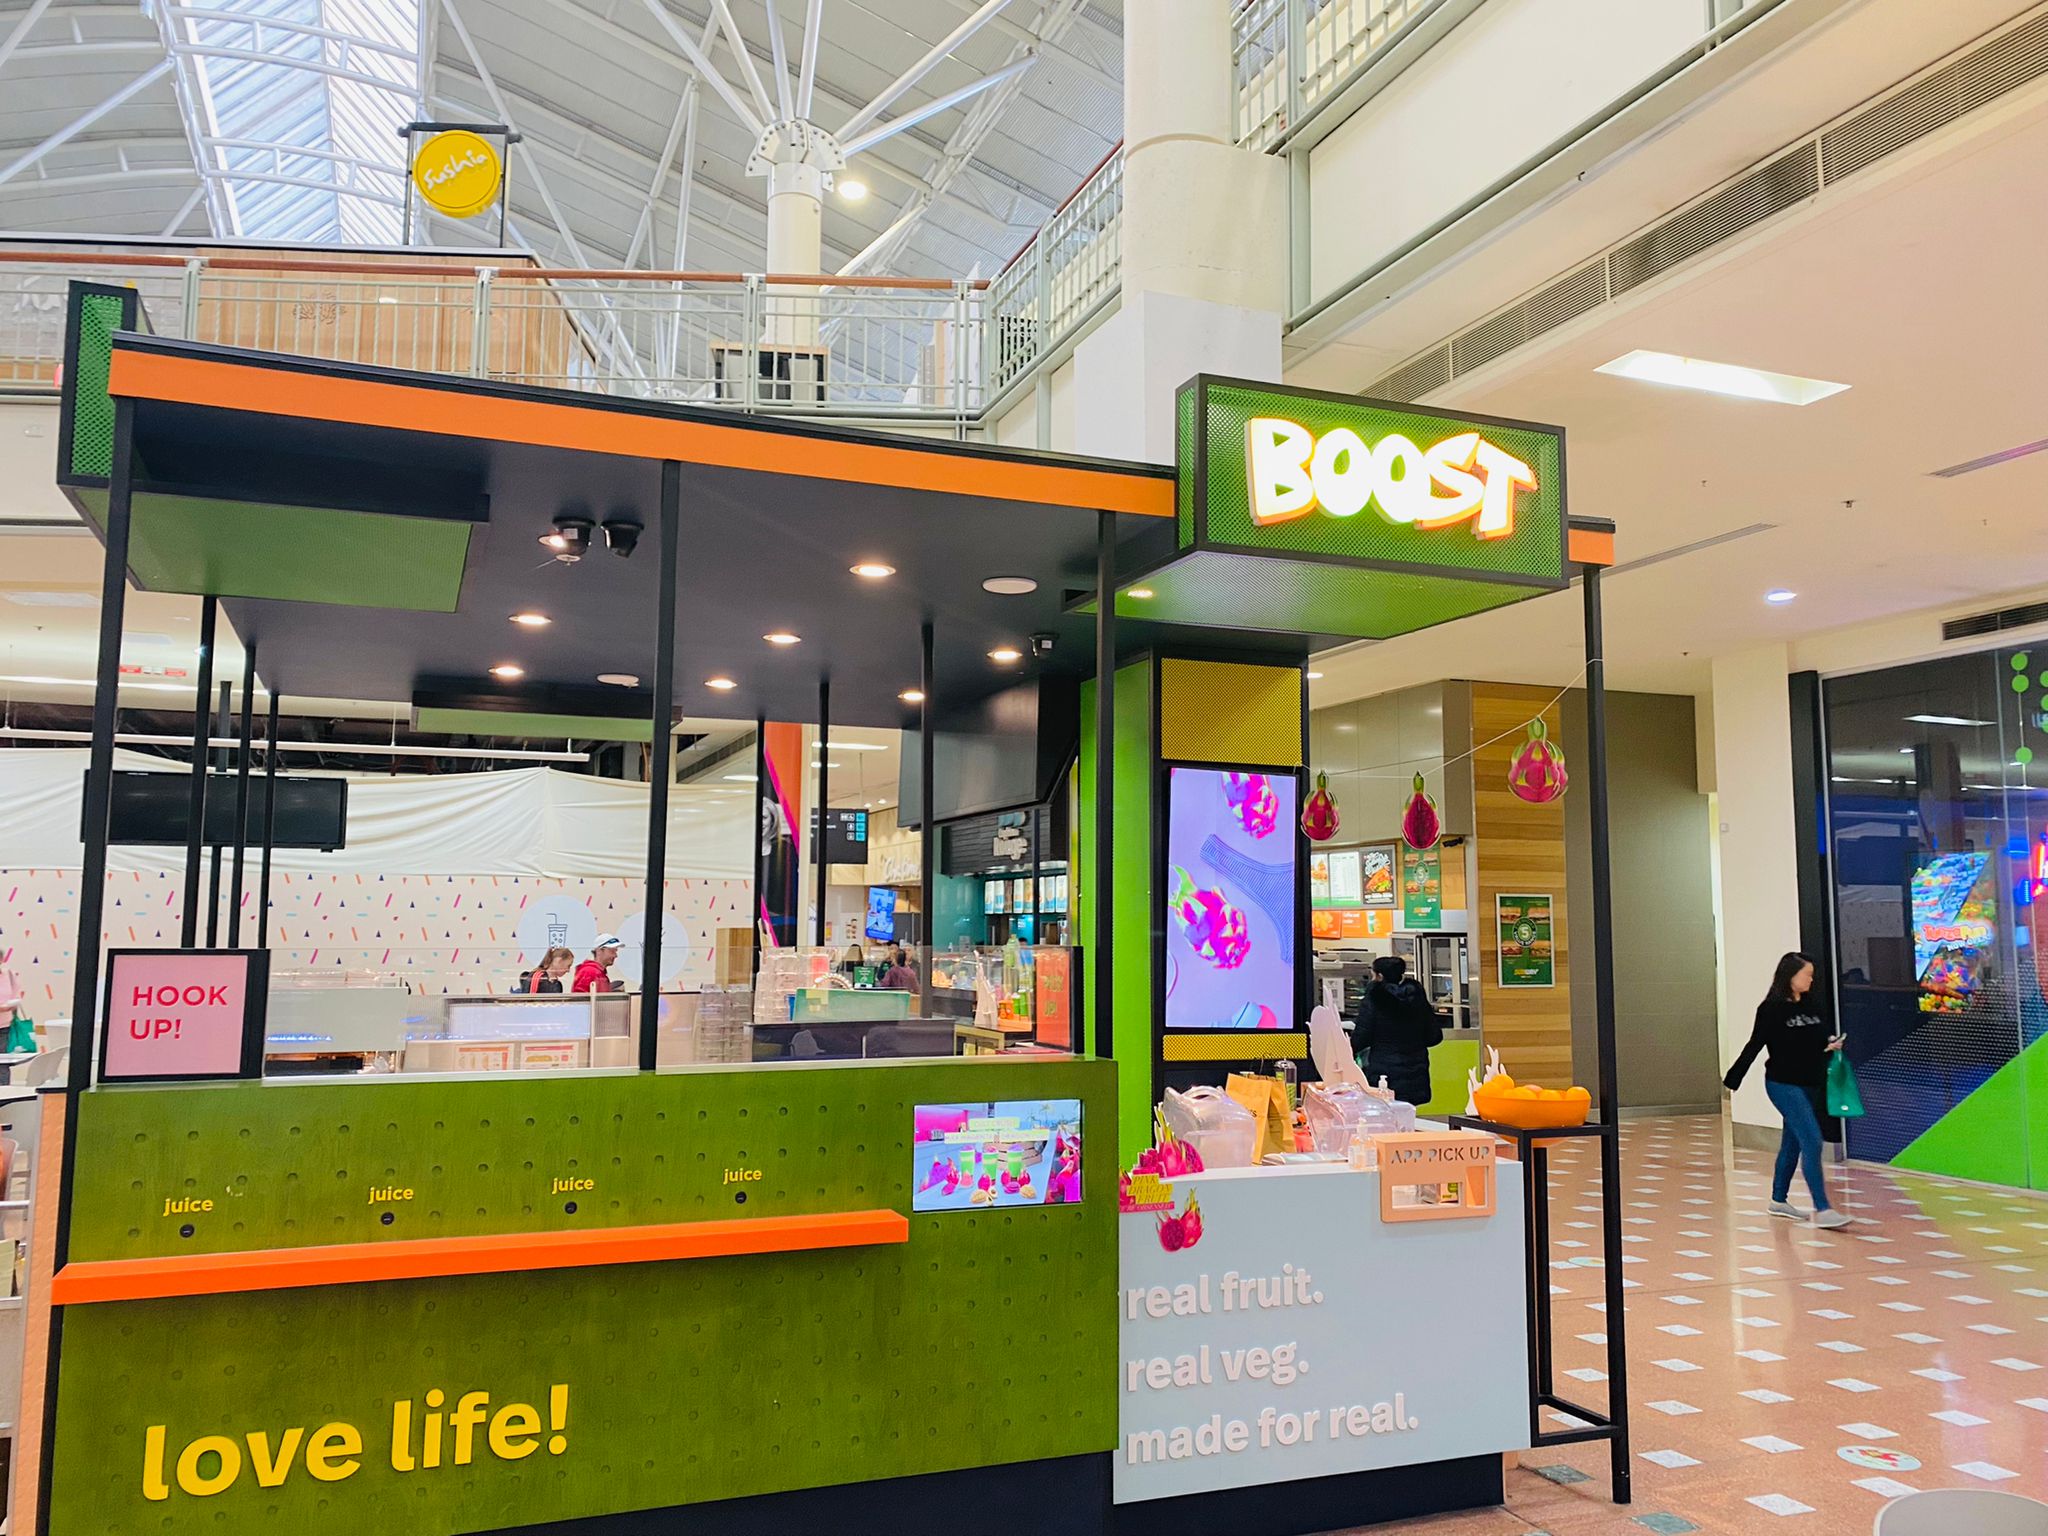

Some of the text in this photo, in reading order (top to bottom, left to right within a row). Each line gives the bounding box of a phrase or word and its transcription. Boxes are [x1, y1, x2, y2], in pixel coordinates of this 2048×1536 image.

[1246, 416, 1538, 540] BOOST
[132, 985, 228, 1007] HOOK
[130, 1018, 182, 1040] UP!
[1391, 1146, 1490, 1164] APP PICK UP
[552, 1176, 595, 1194] juice
[723, 1168, 763, 1185] juice
[163, 1196, 214, 1217] juice
[368, 1186, 414, 1205] juice
[1127, 1263, 1325, 1320] real fruit.
[1127, 1341, 1310, 1392] real veg.
[1127, 1392, 1420, 1465] made for real.
[142, 1384, 569, 1501] love life!
